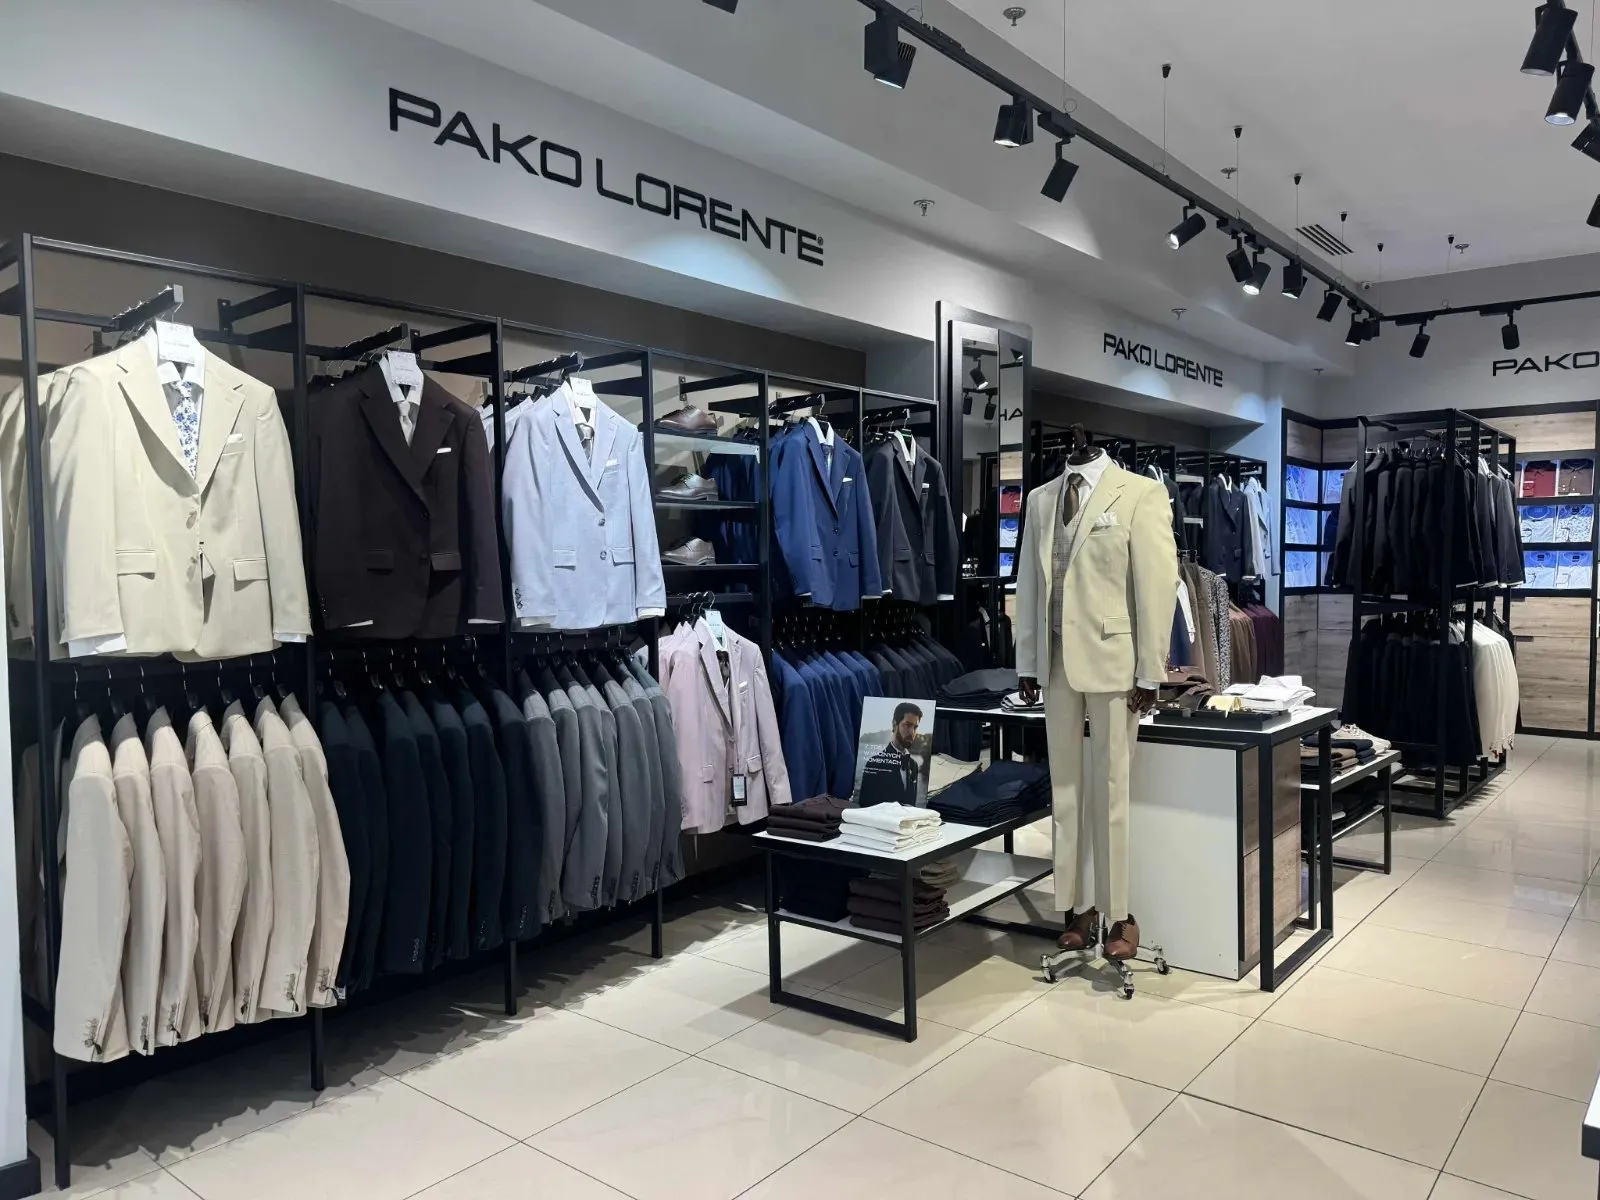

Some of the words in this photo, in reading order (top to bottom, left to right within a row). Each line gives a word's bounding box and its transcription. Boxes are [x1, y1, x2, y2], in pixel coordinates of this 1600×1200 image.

[389, 87, 582, 188] PAKO
[1104, 332, 1151, 366] PAKO
[1154, 348, 1223, 387] LORENTE
[1492, 350, 1600, 376] PAKO
[863, 757, 902, 765] MOMENTACH
